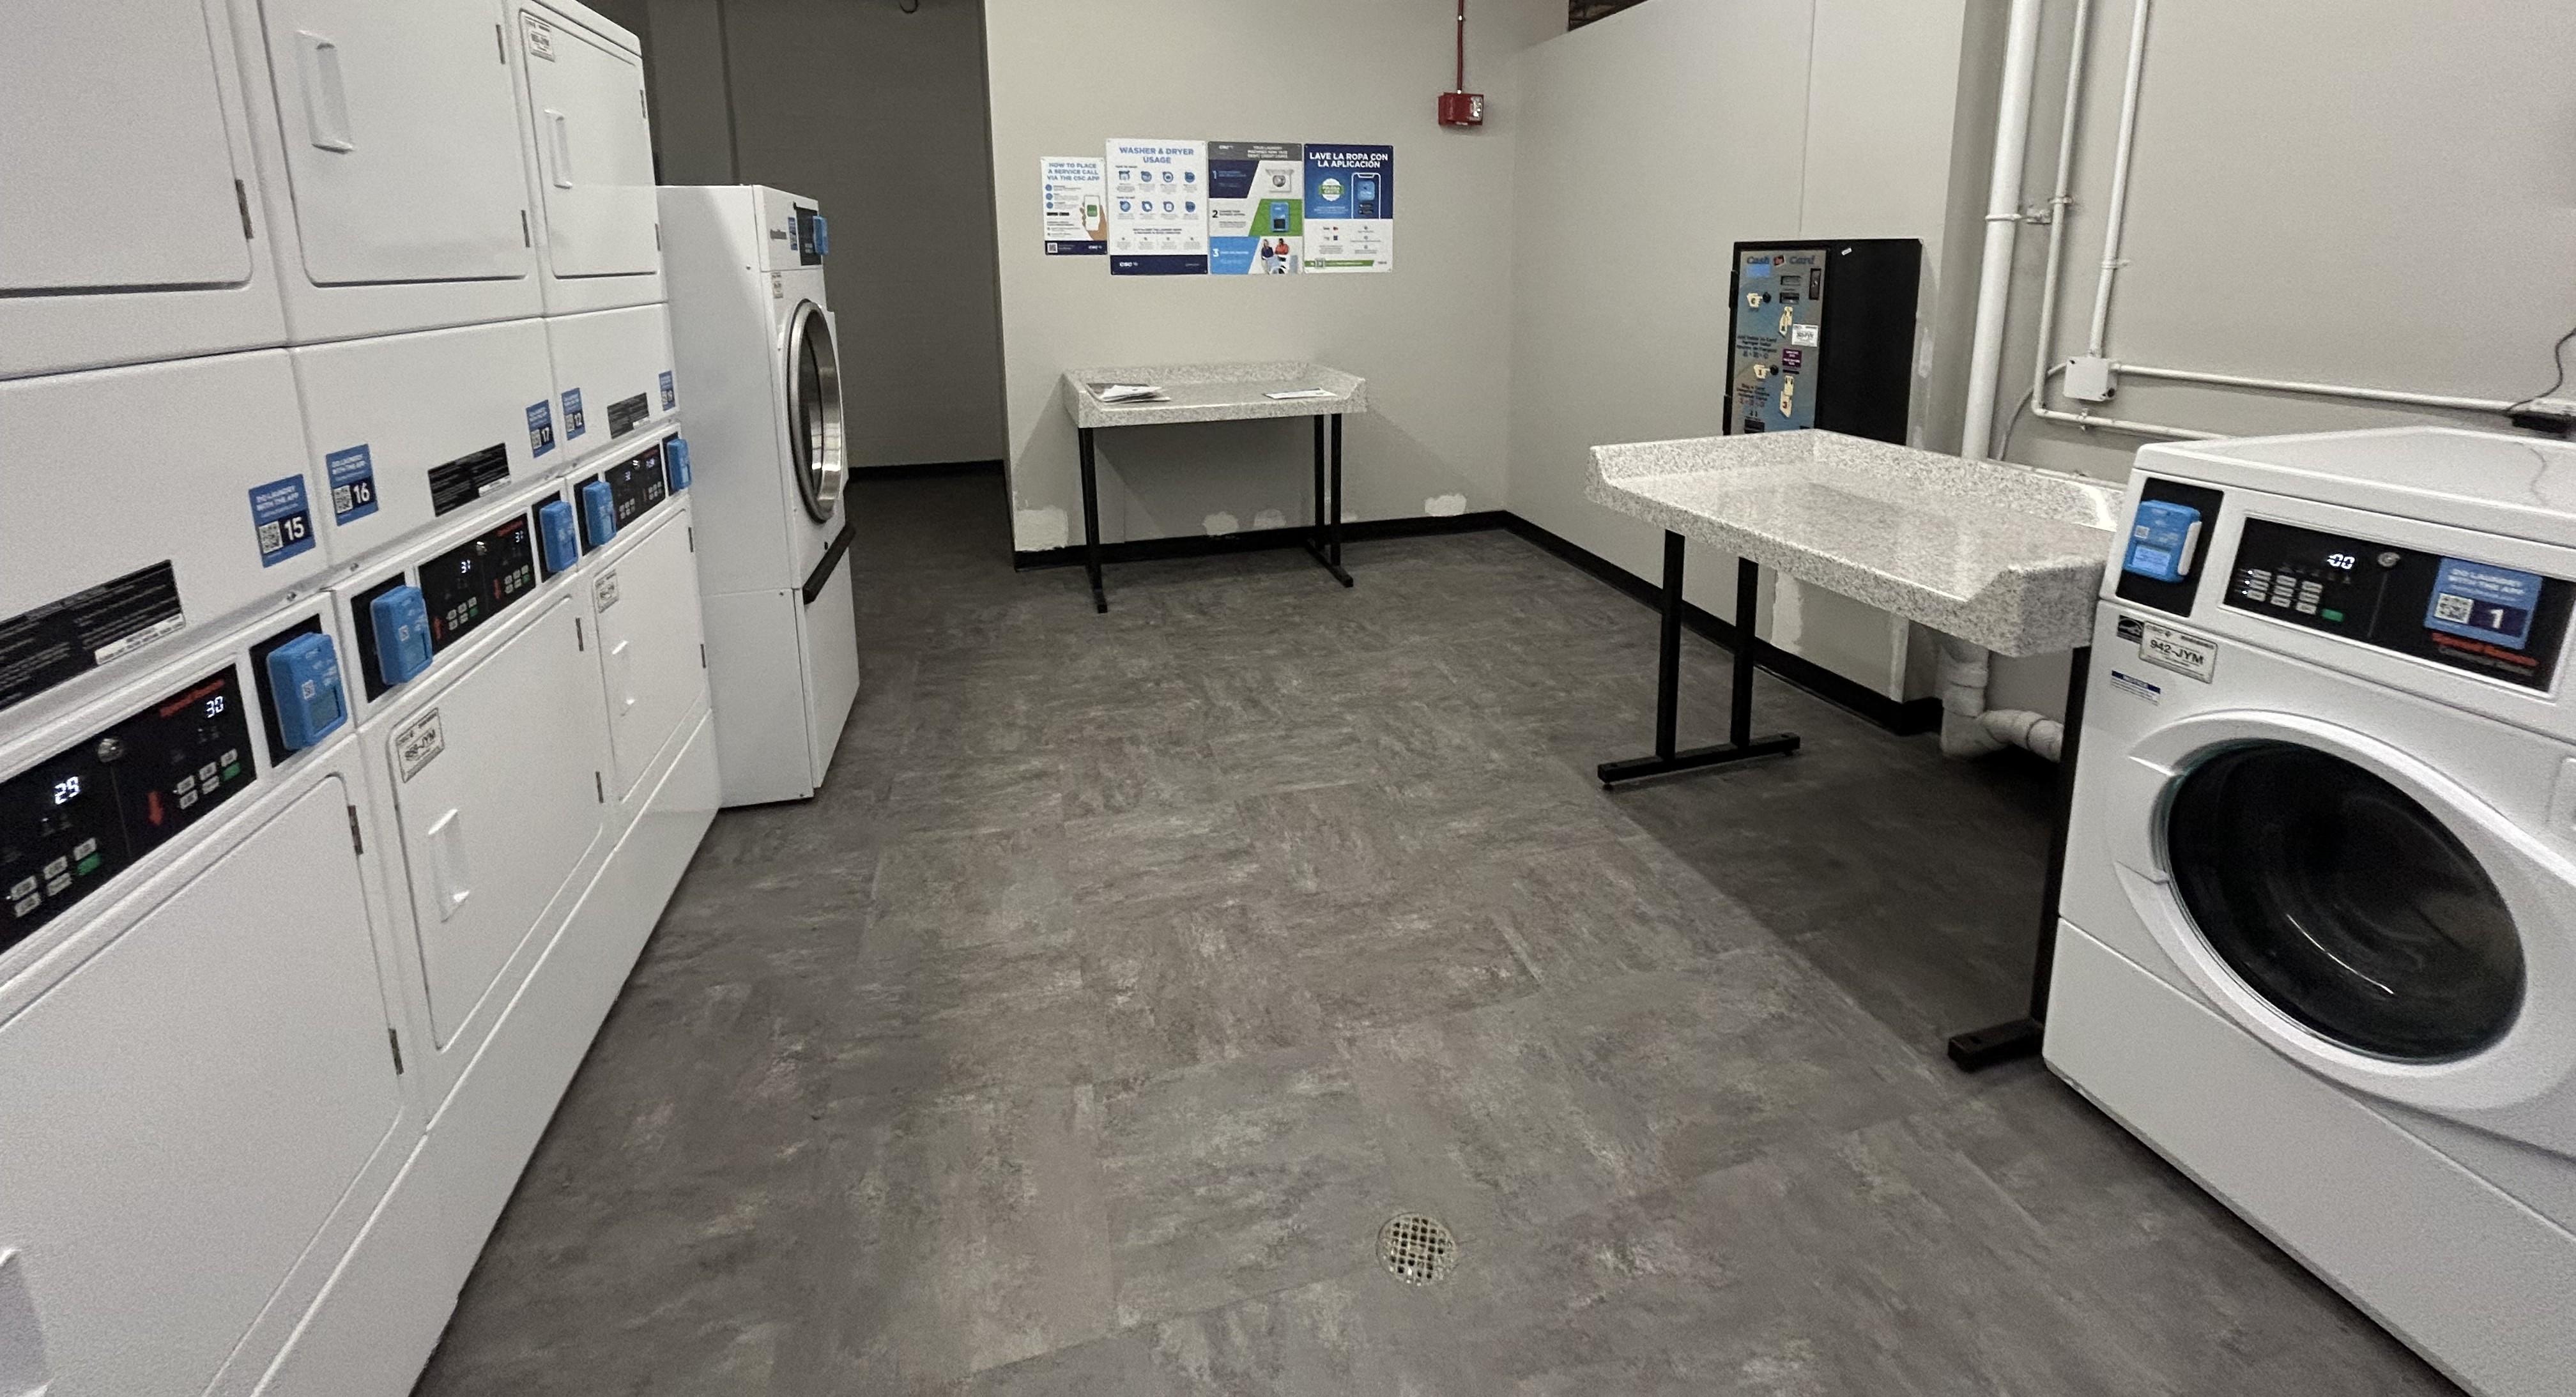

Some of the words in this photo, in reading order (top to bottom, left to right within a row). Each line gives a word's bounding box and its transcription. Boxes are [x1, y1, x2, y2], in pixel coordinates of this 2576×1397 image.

[1331, 159, 1381, 168] APLICACIÓN
[1213, 171, 1217, 179] 1
[1212, 210, 1218, 218] 2
[1213, 248, 1219, 257] 3
[1747, 256, 1770, 264] Cash
[1790, 256, 1816, 264] Card
[542, 427, 549, 443] 17
[353, 482, 371, 503] 16
[284, 516, 305, 541] 15
[2490, 609, 2504, 629] 1
[206, 696, 224, 718] 30
[54, 776, 80, 805] 29
